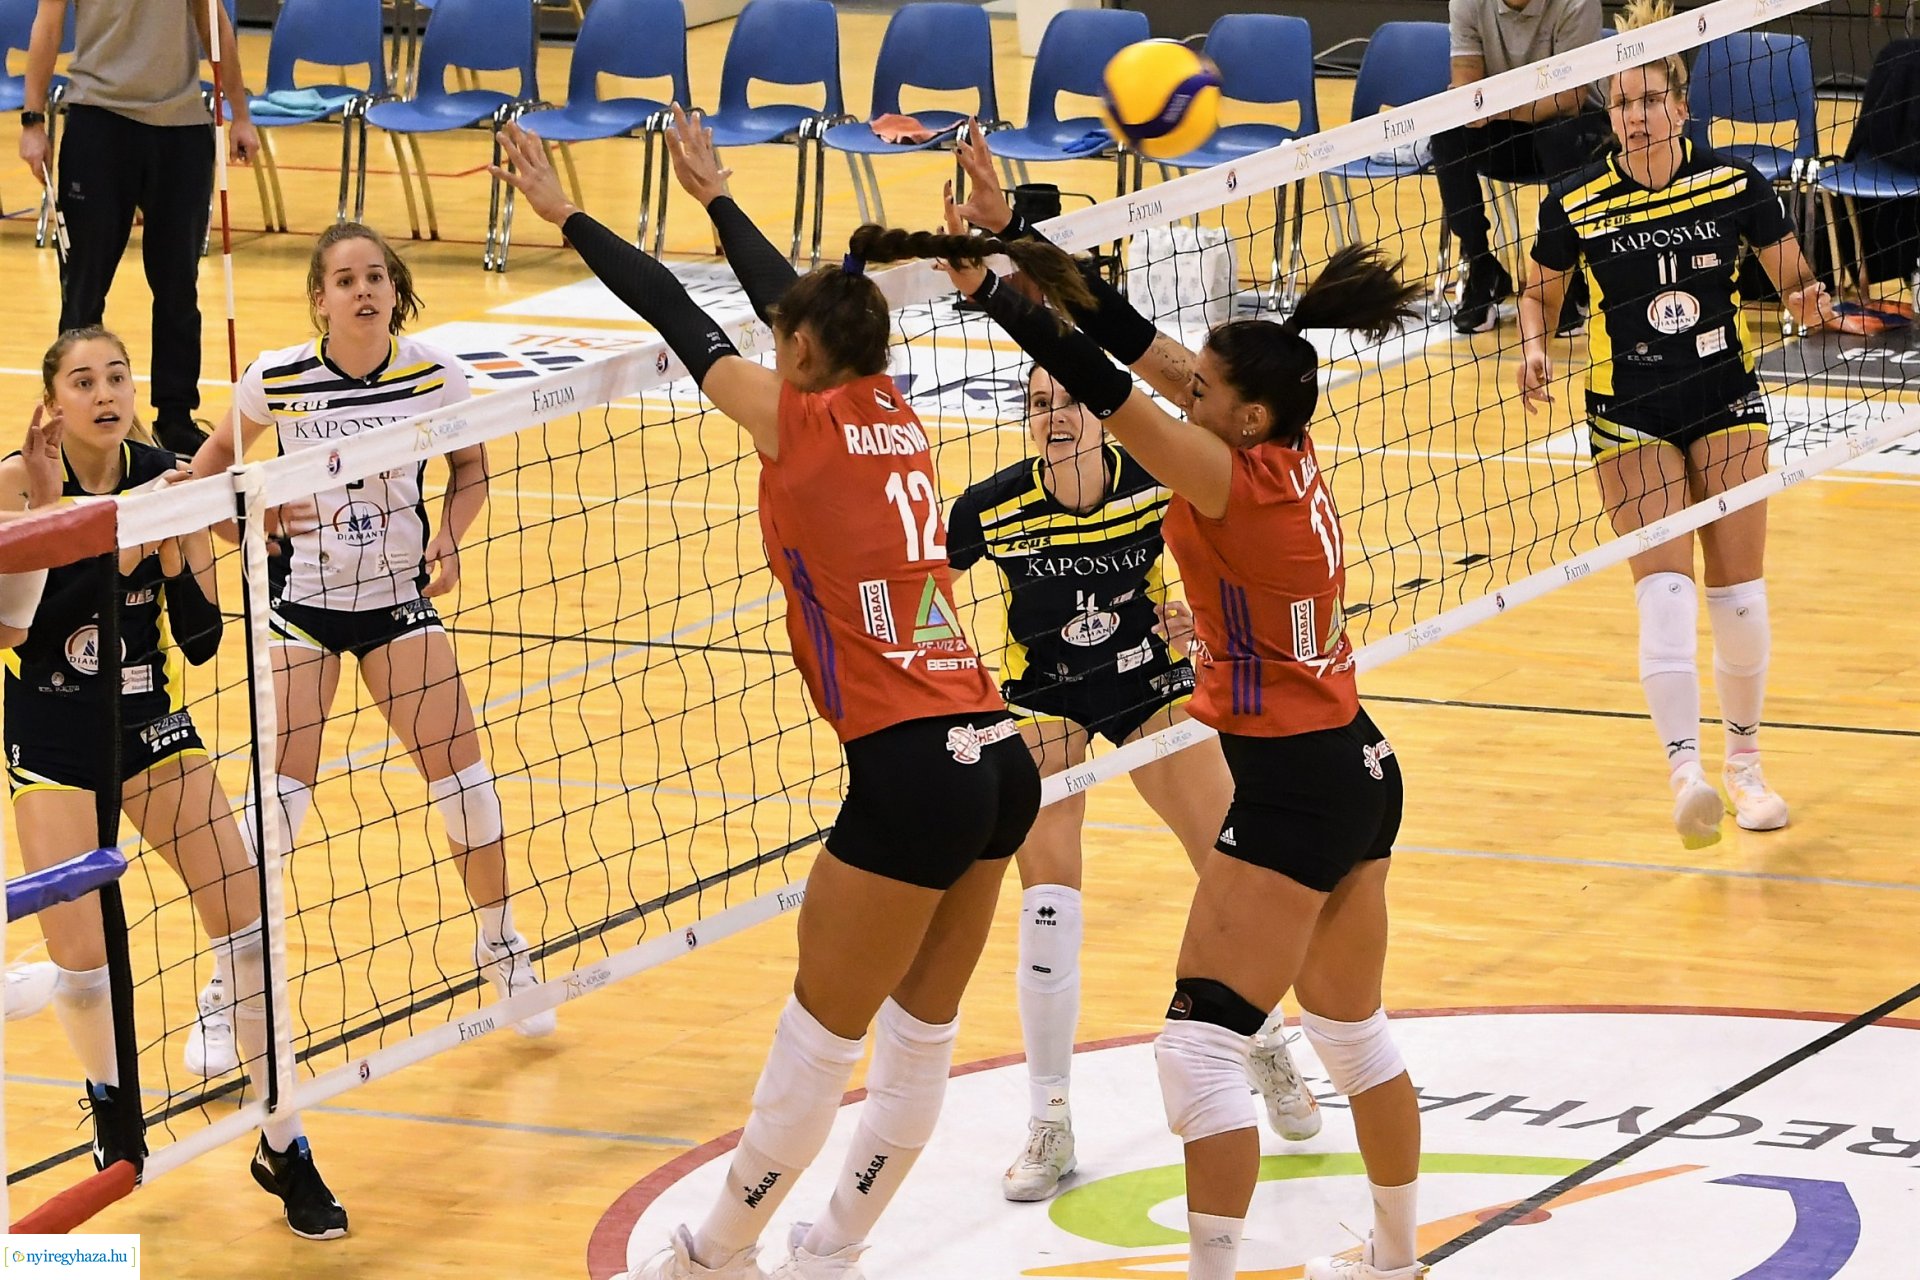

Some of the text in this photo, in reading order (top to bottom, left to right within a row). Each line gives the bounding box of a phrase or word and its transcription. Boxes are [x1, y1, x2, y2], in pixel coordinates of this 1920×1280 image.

[1616, 41, 1645, 63] FATUM
[1383, 118, 1415, 139] FATUM
[1128, 200, 1163, 222] FATUM
[1657, 251, 1677, 285] 11
[532, 386, 575, 413] FATUM
[1781, 470, 1805, 487] FATUM
[885, 471, 947, 562] 12
[337, 531, 385, 541] DIAMANT
[1025, 548, 1147, 577] KAPOSVÁR
[1564, 563, 1591, 582] FATUM
[869, 584, 889, 642] TRABAG
[1300, 602, 1311, 657] STRABAG
[1065, 772, 1097, 793] FATUM
[778, 889, 807, 911] FATU
[458, 1017, 495, 1042] FATUM
[856, 1154, 889, 1195] MIKASA
[744, 1171, 782, 1209] MIKASA
